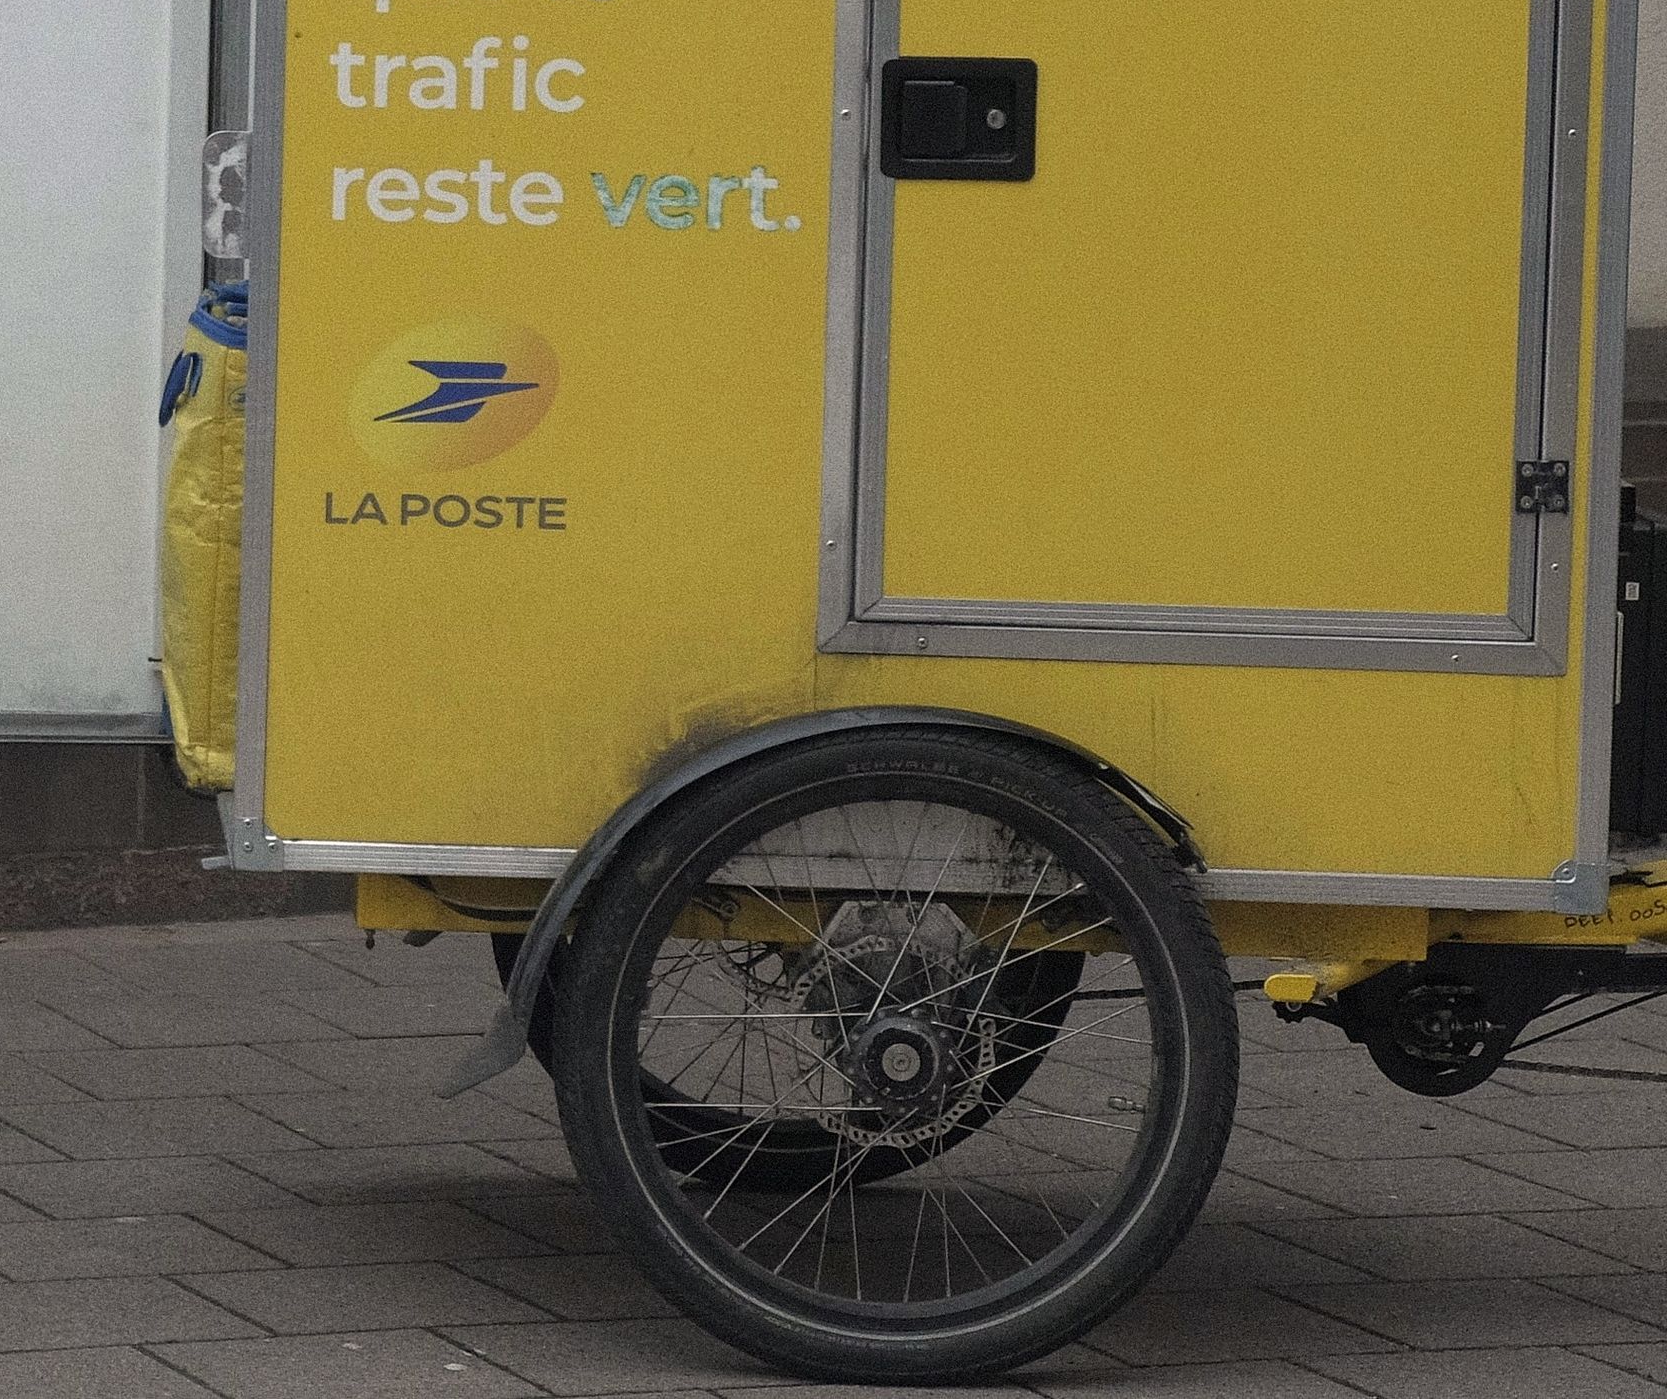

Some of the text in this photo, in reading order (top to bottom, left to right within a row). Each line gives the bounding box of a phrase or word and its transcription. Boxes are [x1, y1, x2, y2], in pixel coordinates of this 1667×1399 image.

[329, 35, 586, 114] trafic
[331, 159, 802, 232] reste vert.
[323, 491, 567, 531] LA POSTE
